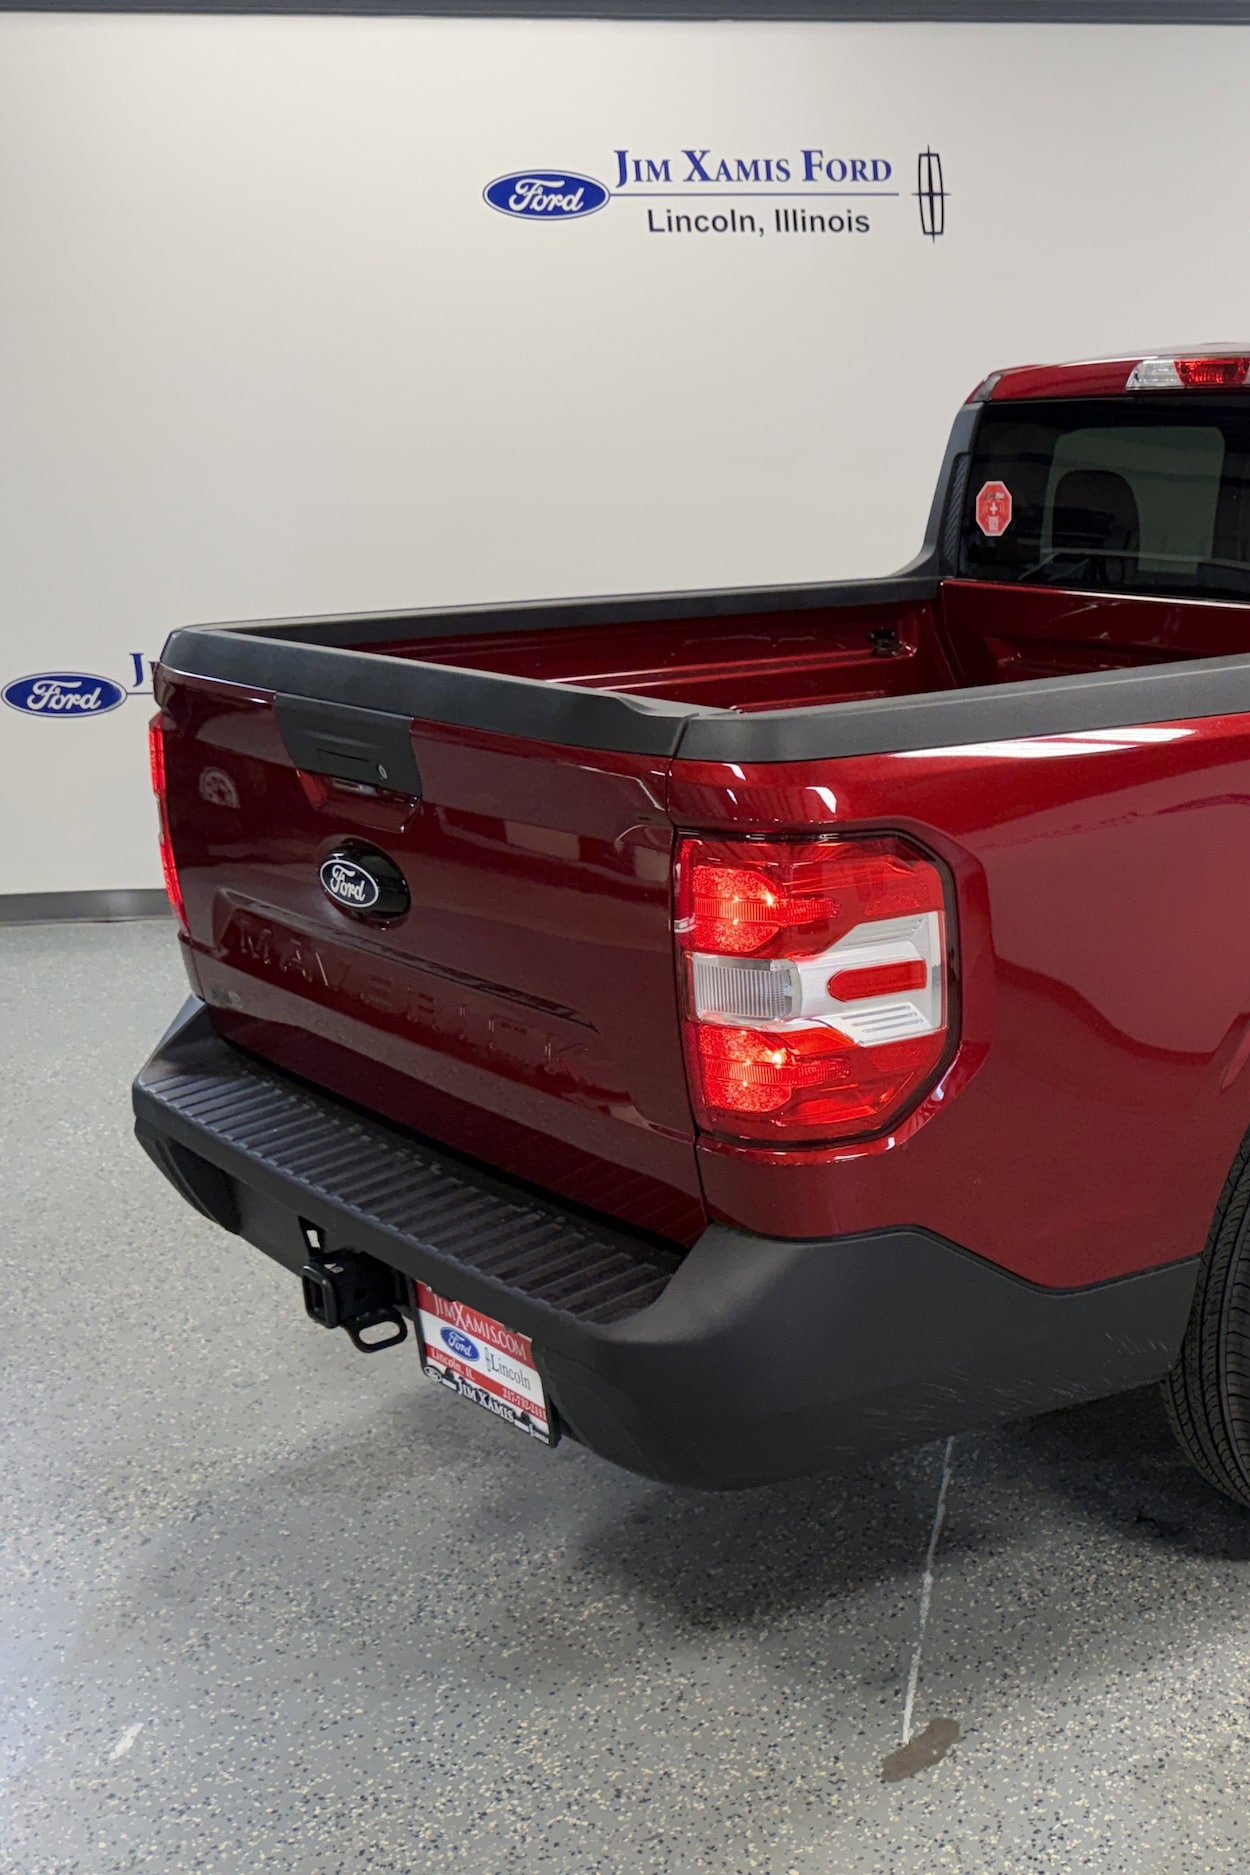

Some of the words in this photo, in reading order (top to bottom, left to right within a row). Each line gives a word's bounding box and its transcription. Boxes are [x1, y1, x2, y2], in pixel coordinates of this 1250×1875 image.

[508, 178, 584, 213] Ford
[647, 209, 764, 238] Lincoln,
[775, 209, 870, 234] Illinois
[27, 679, 102, 710] Ford
[330, 864, 366, 902] Ford
[238, 919, 591, 1082] MAVERICK
[448, 1331, 473, 1358] Ford
[490, 1352, 532, 1391] Lincoln
